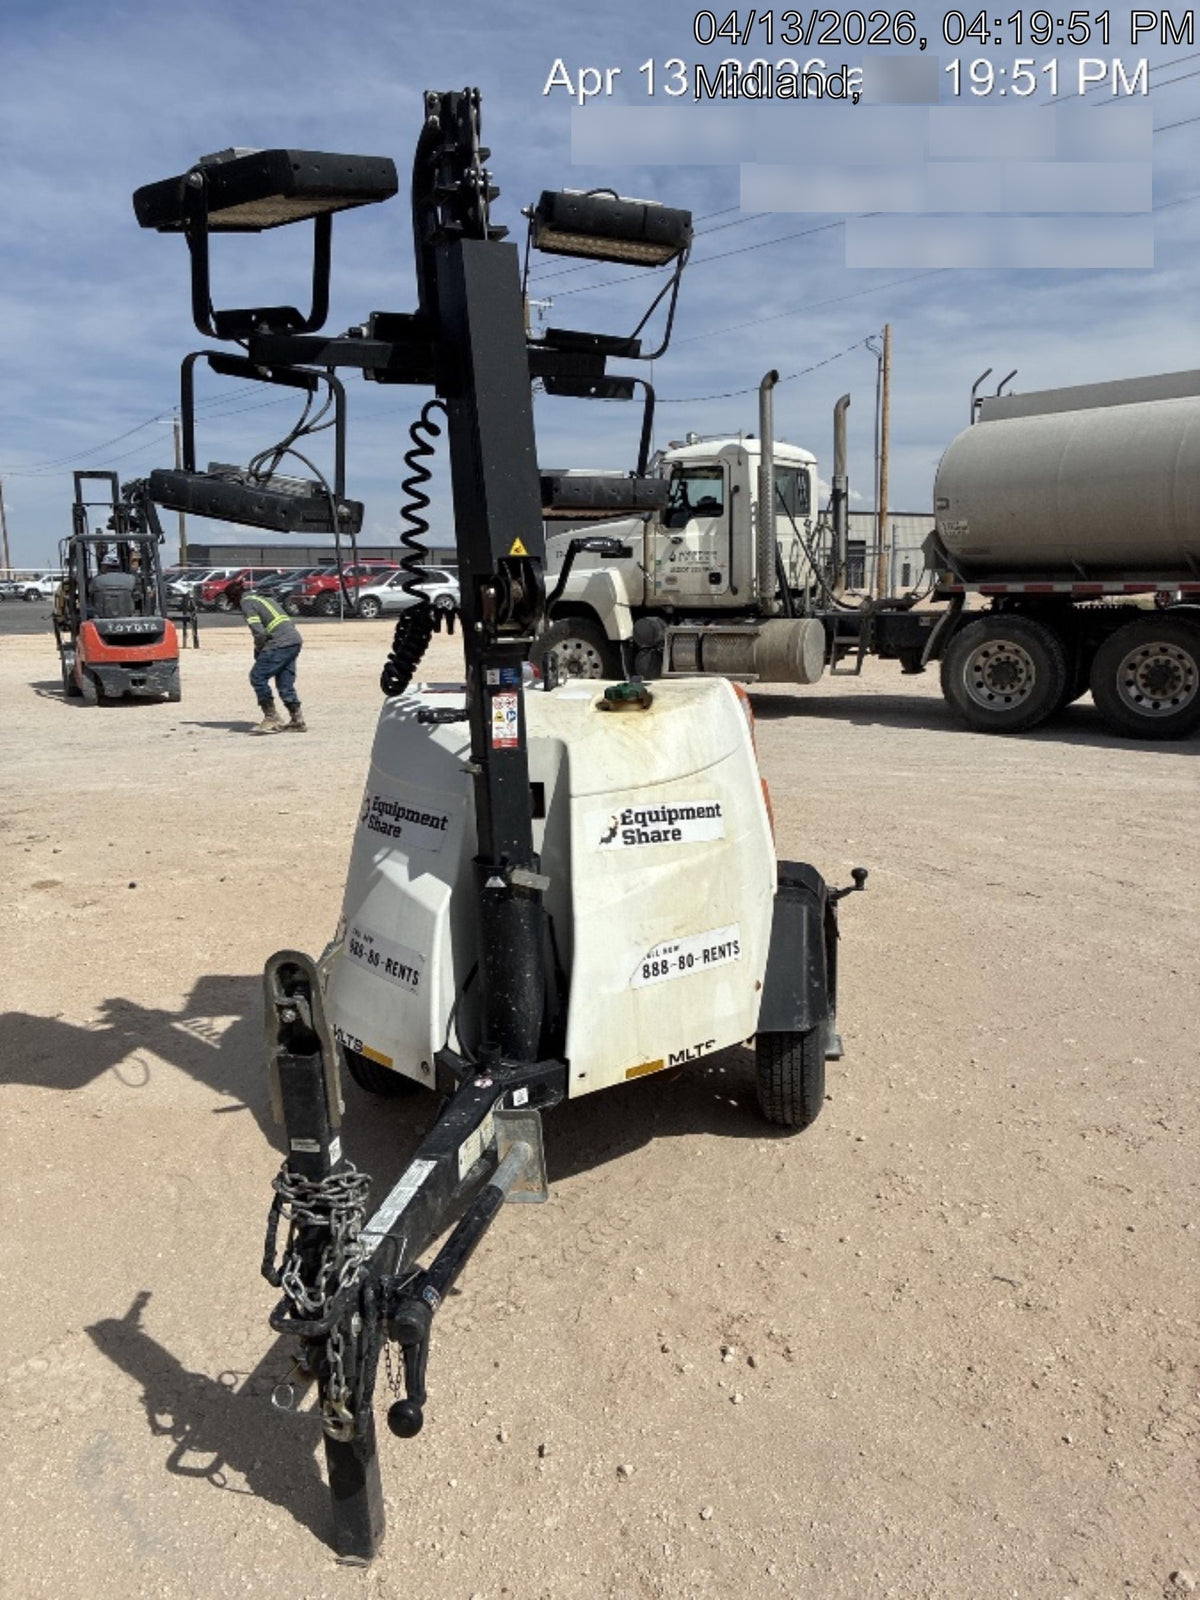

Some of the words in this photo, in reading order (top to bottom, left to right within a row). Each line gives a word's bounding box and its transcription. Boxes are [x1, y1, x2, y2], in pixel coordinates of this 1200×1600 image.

[107, 623, 158, 632] TOYOTA
[371, 796, 449, 831] Equipment
[620, 803, 722, 828] Equipment
[368, 814, 402, 838] Share
[621, 828, 682, 845] Share
[642, 940, 740, 979] 888-80-RENTS
